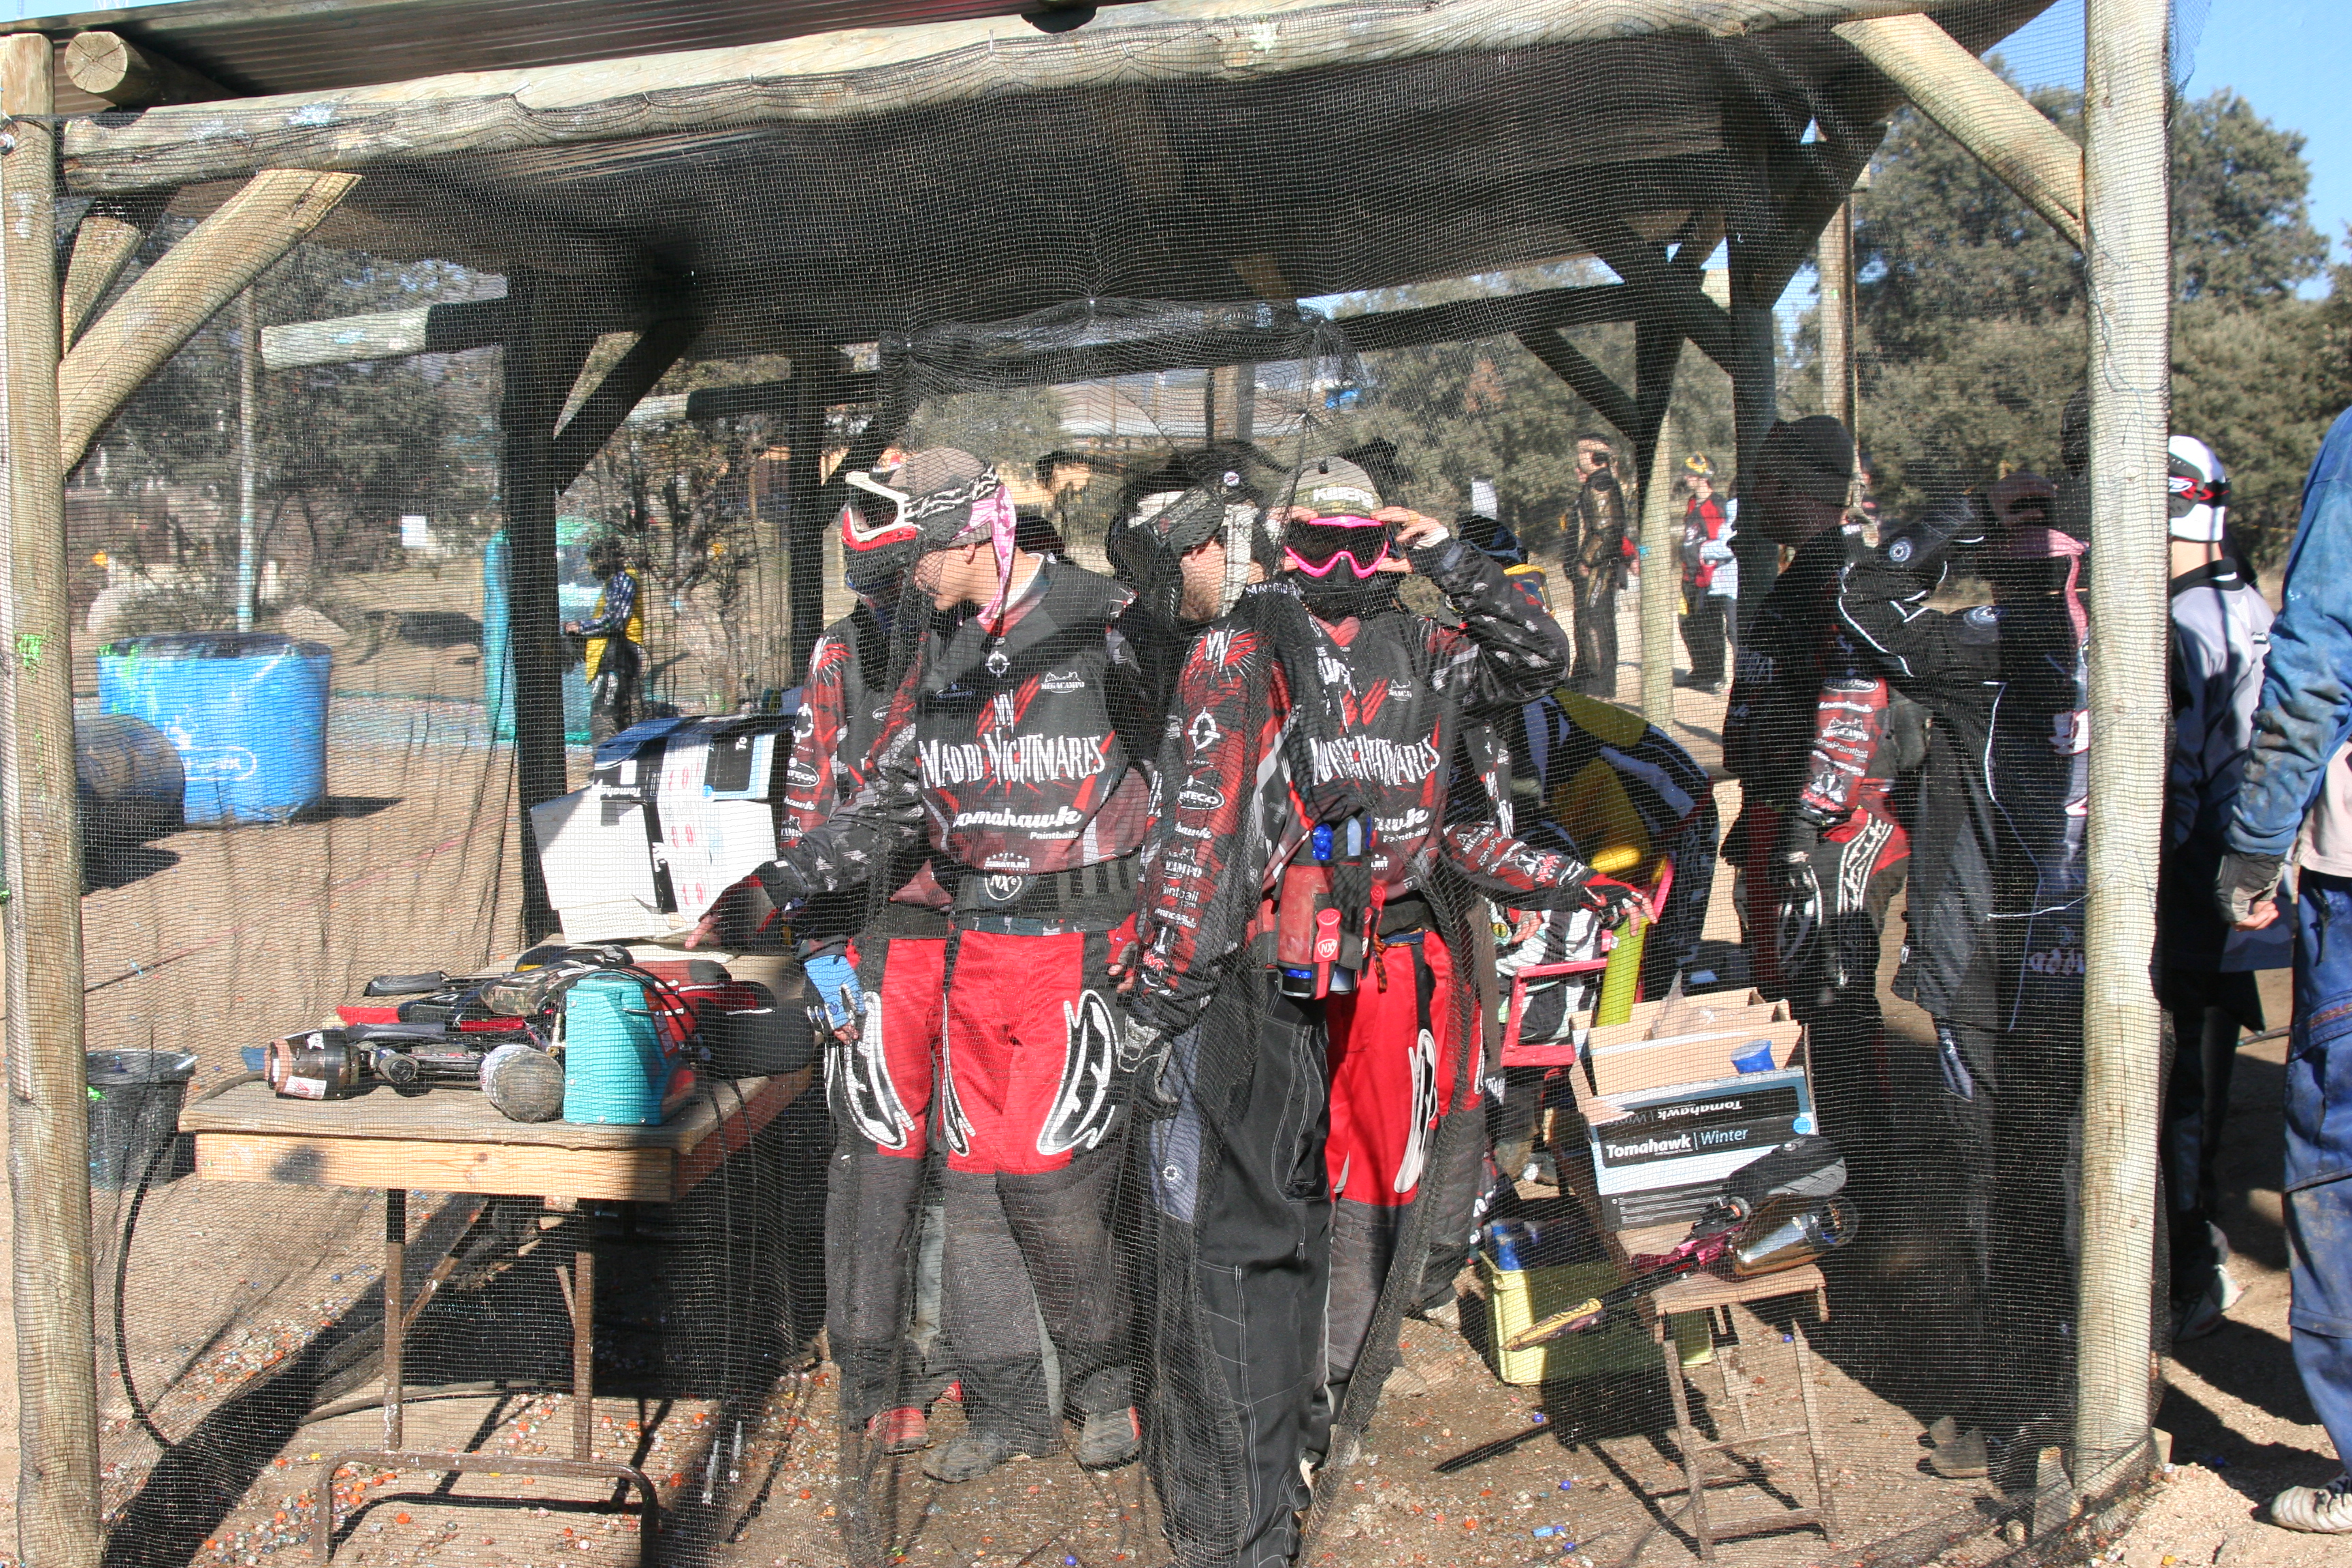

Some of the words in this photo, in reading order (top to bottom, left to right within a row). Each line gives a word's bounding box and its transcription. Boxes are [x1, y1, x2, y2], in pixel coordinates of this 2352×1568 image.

[1030, 830, 1080, 840] Paintballs
[1658, 1100, 1743, 1121] Tomahawk
[1605, 1134, 1692, 1159] Tomahawk
[1701, 1128, 1748, 1146] Winter
